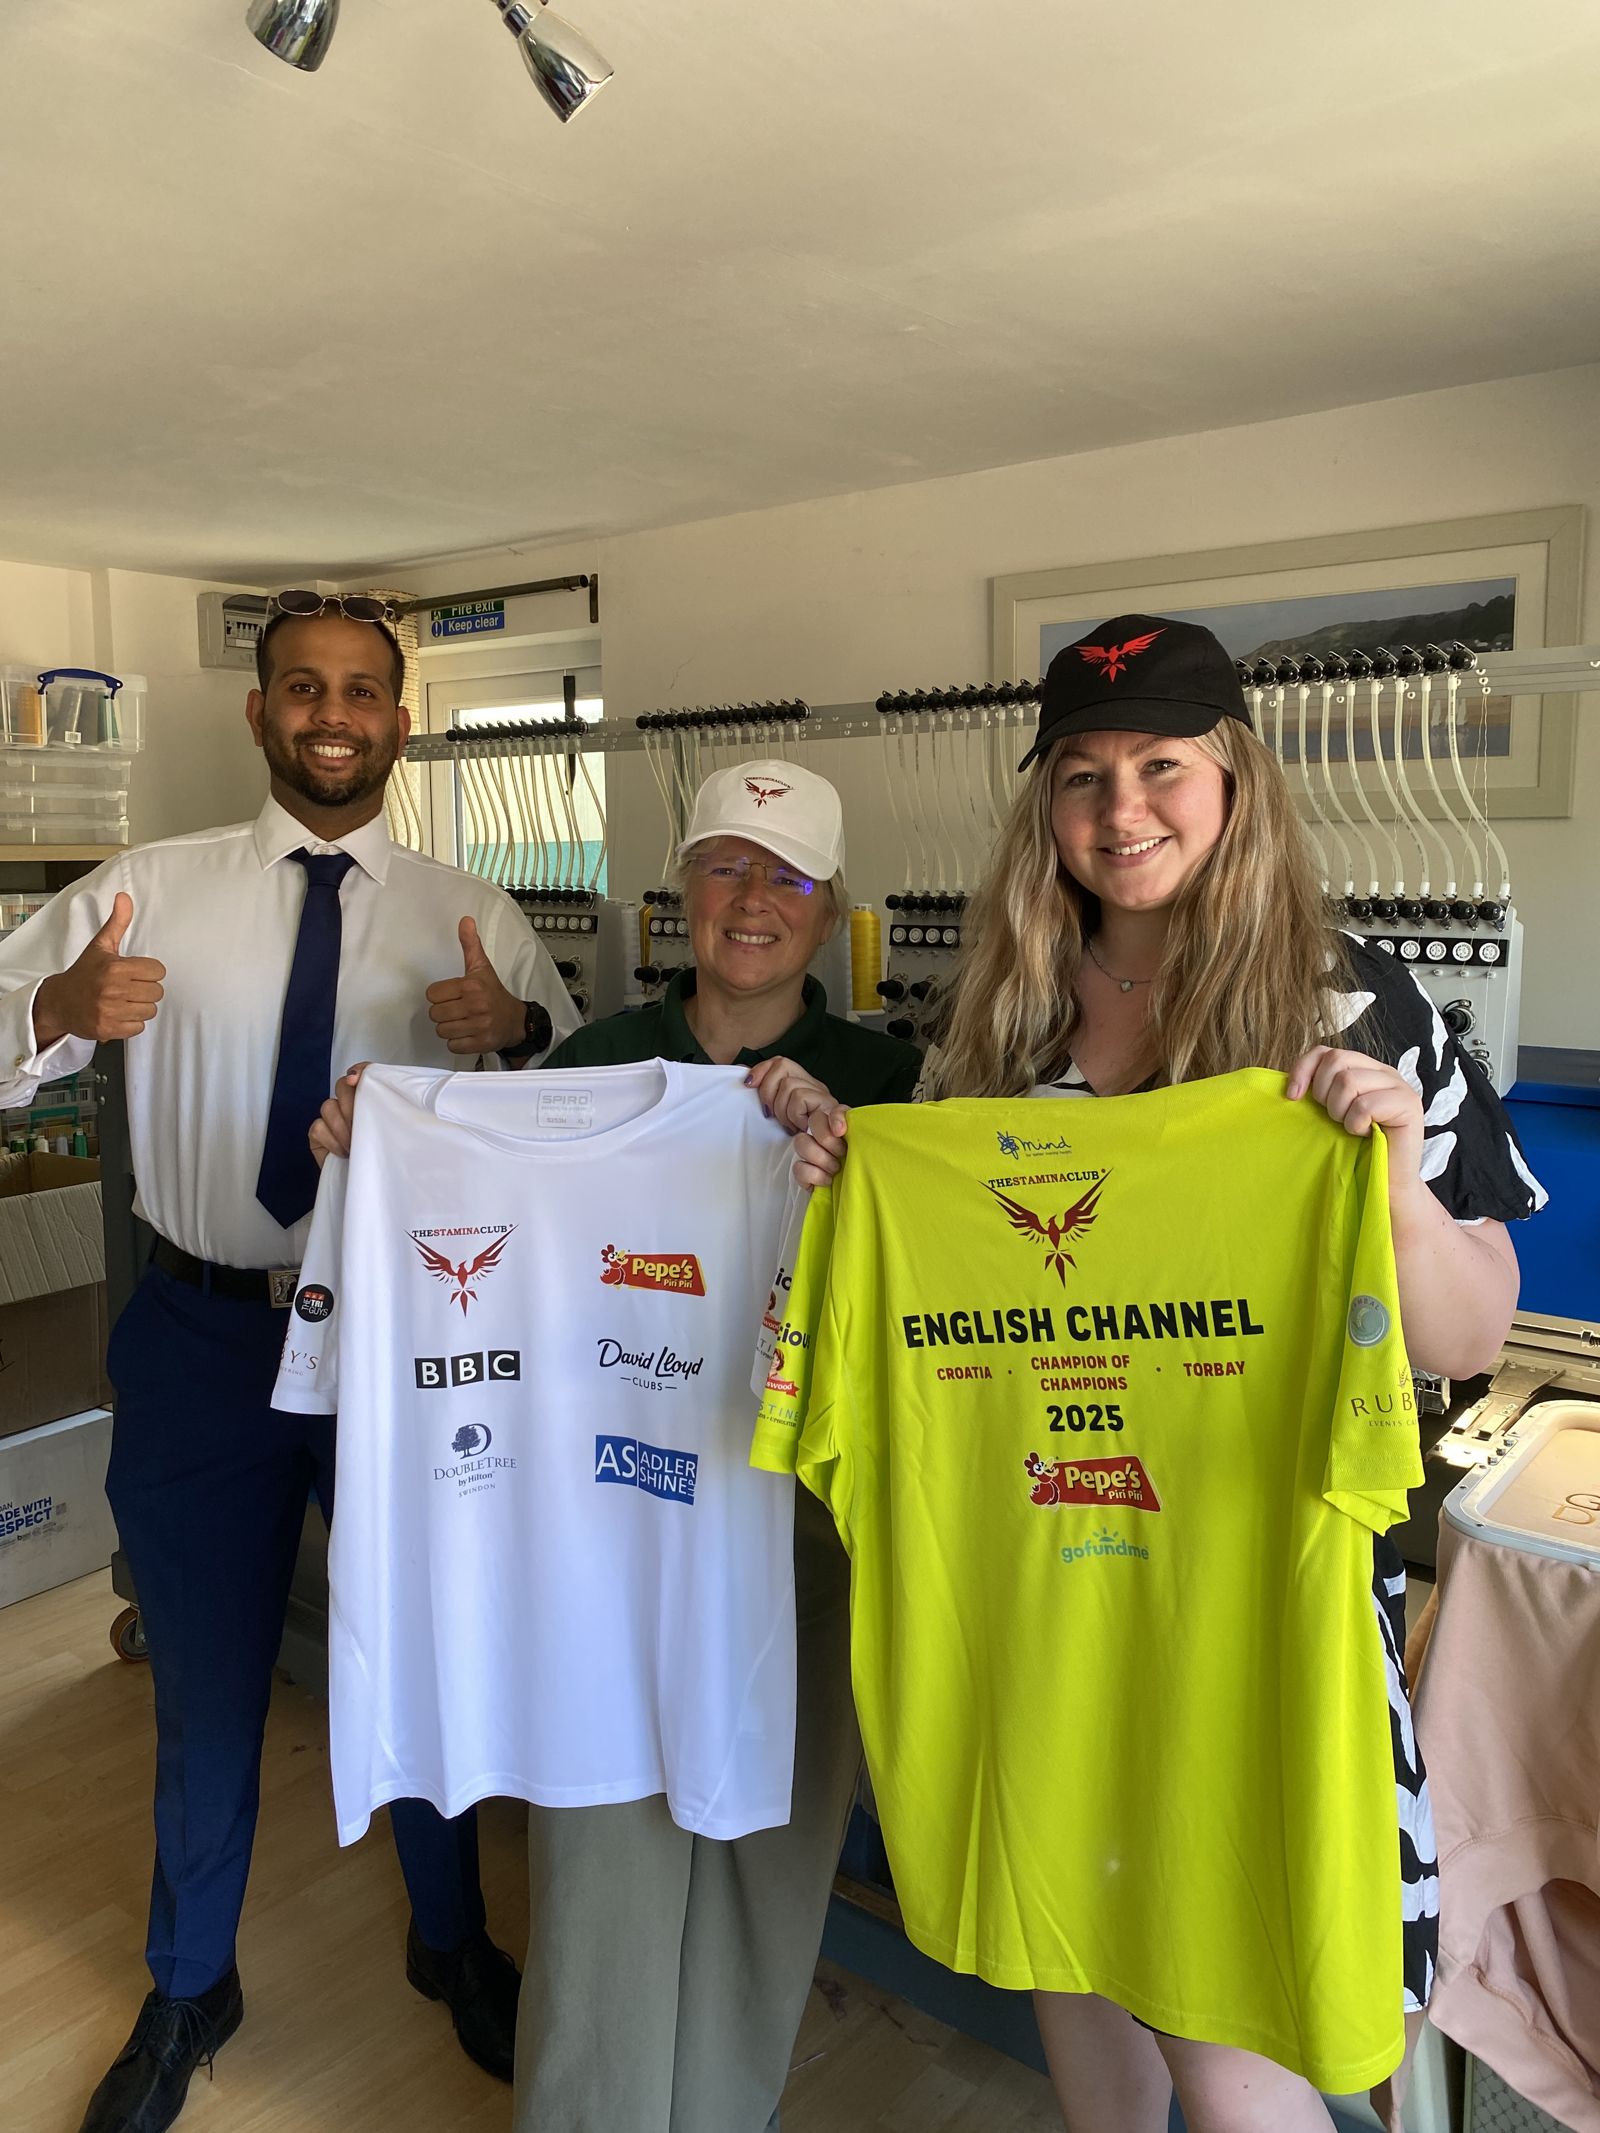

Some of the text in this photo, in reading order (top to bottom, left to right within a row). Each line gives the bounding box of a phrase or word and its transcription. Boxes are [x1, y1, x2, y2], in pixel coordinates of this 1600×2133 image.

[448, 616, 499, 632] Keep clear
[542, 1095, 588, 1105] SPIRO
[1020, 1135, 1072, 1151] mind
[988, 1170, 1100, 1189] THESTAMINACLUB
[412, 1225, 508, 1238] THESTAMINACLUB
[632, 1257, 694, 1282] Pepe's
[663, 1278, 693, 1289] Piri Piri
[308, 1306, 329, 1317] GUYS
[311, 1299, 324, 1308] TRI
[902, 1298, 1265, 1349] ENGLISH CHANNEL
[597, 1338, 704, 1381] David Lloyd
[1031, 1355, 1130, 1372] CHAMPION OF
[420, 1352, 517, 1386] BBC
[936, 1366, 992, 1382] CROATIA
[1183, 1361, 1246, 1378] TORBAY
[632, 1377, 663, 1391] CLUBS
[766, 1381, 793, 1391] swood
[1040, 1377, 1128, 1392] CHAMPIONS
[1351, 1392, 1413, 1417] RUB
[1047, 1405, 1124, 1432] 2025
[596, 1442, 636, 1479] AS
[640, 1450, 696, 1478] ADLER
[458, 1472, 493, 1487] by Hilton
[640, 1466, 688, 1495] SHINE
[1065, 1464, 1141, 1496] Pepe's
[458, 1483, 496, 1498] SWINDON
[1108, 1489, 1143, 1501] Piri Piri
[0, 1496, 52, 1522] ADE WITH
[0, 1507, 52, 1537] ESPECT
[1061, 1537, 1149, 1564] gofundme
